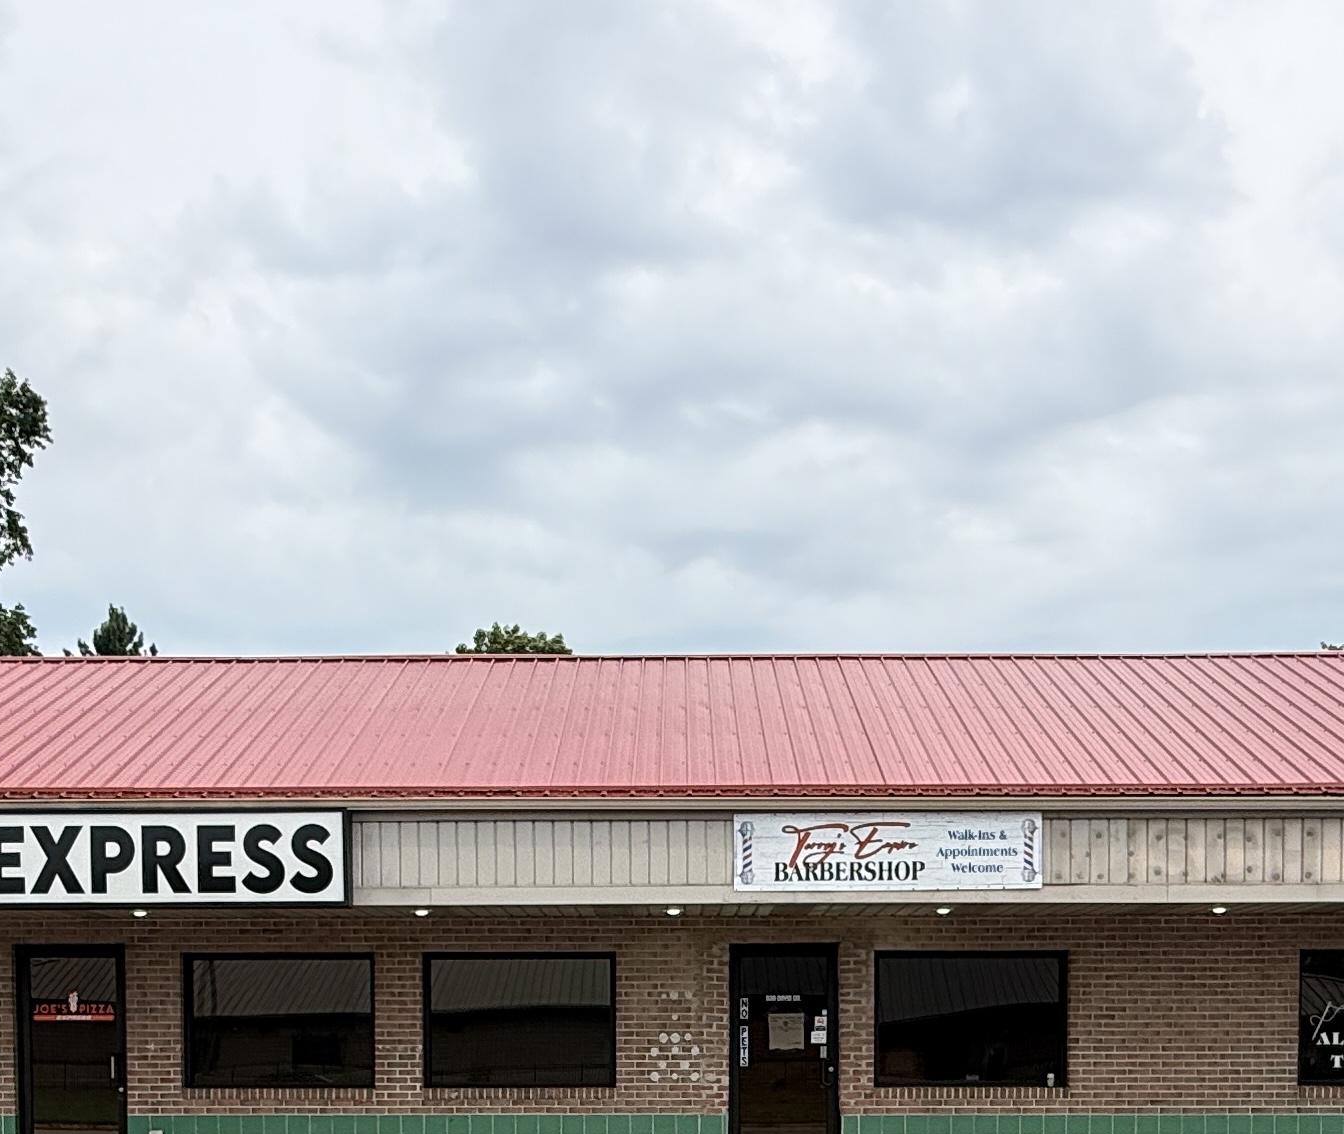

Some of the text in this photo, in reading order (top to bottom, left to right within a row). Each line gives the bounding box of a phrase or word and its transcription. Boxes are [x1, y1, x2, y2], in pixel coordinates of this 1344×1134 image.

[947, 829, 997, 841] Walk-Ins
[936, 845, 1018, 858] Appointments
[774, 860, 926, 882] BARBERSHOP
[951, 862, 1003, 873] Welcome
[33, 1004, 115, 1014] JOE'S PIZZA
[741, 999, 748, 1018] NO
